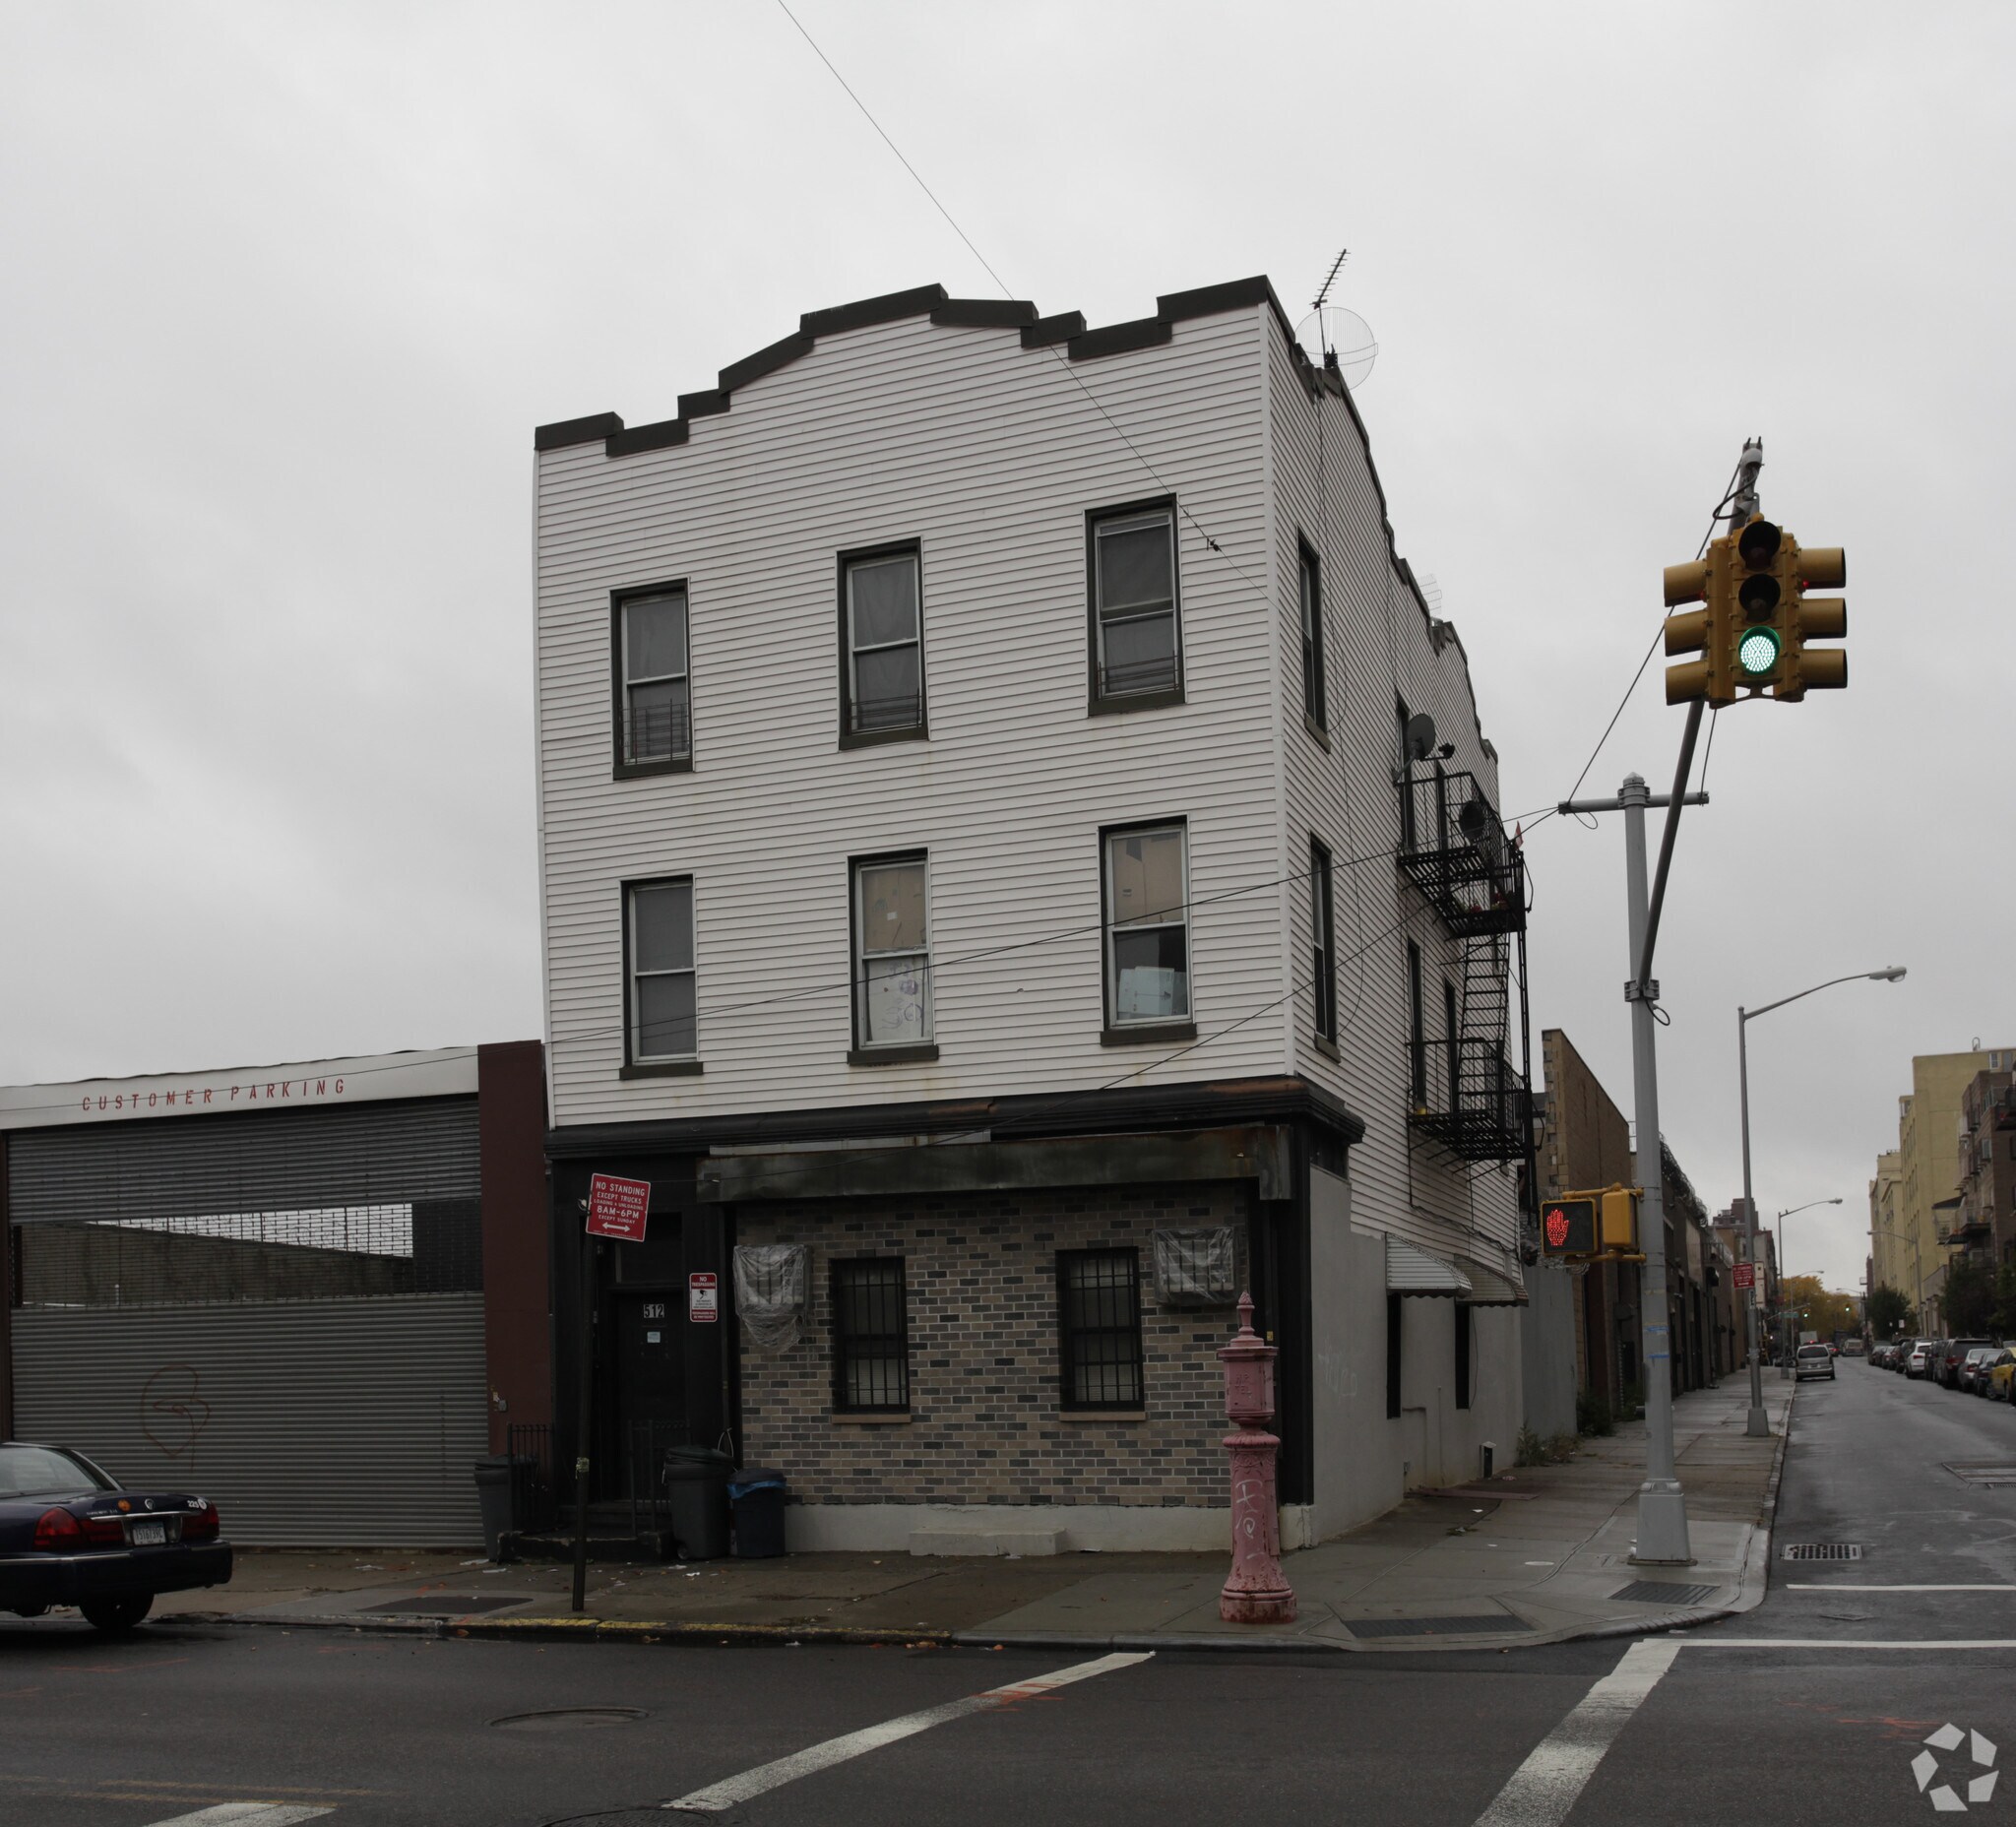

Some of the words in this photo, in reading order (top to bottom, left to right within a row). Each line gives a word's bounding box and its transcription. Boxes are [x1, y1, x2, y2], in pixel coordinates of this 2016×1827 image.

[83, 1089, 213, 1111] CUSTOMER
[230, 1079, 345, 1102] PARKING
[596, 1181, 606, 1190] NO
[609, 1183, 645, 1196] STANDING
[597, 1191, 619, 1201] EXCEPT
[620, 1195, 642, 1205] TRUCKS
[597, 1205, 640, 1220] 8AM-6PM
[618, 1202, 644, 1211] UNLOADING
[645, 1304, 663, 1317] 512
